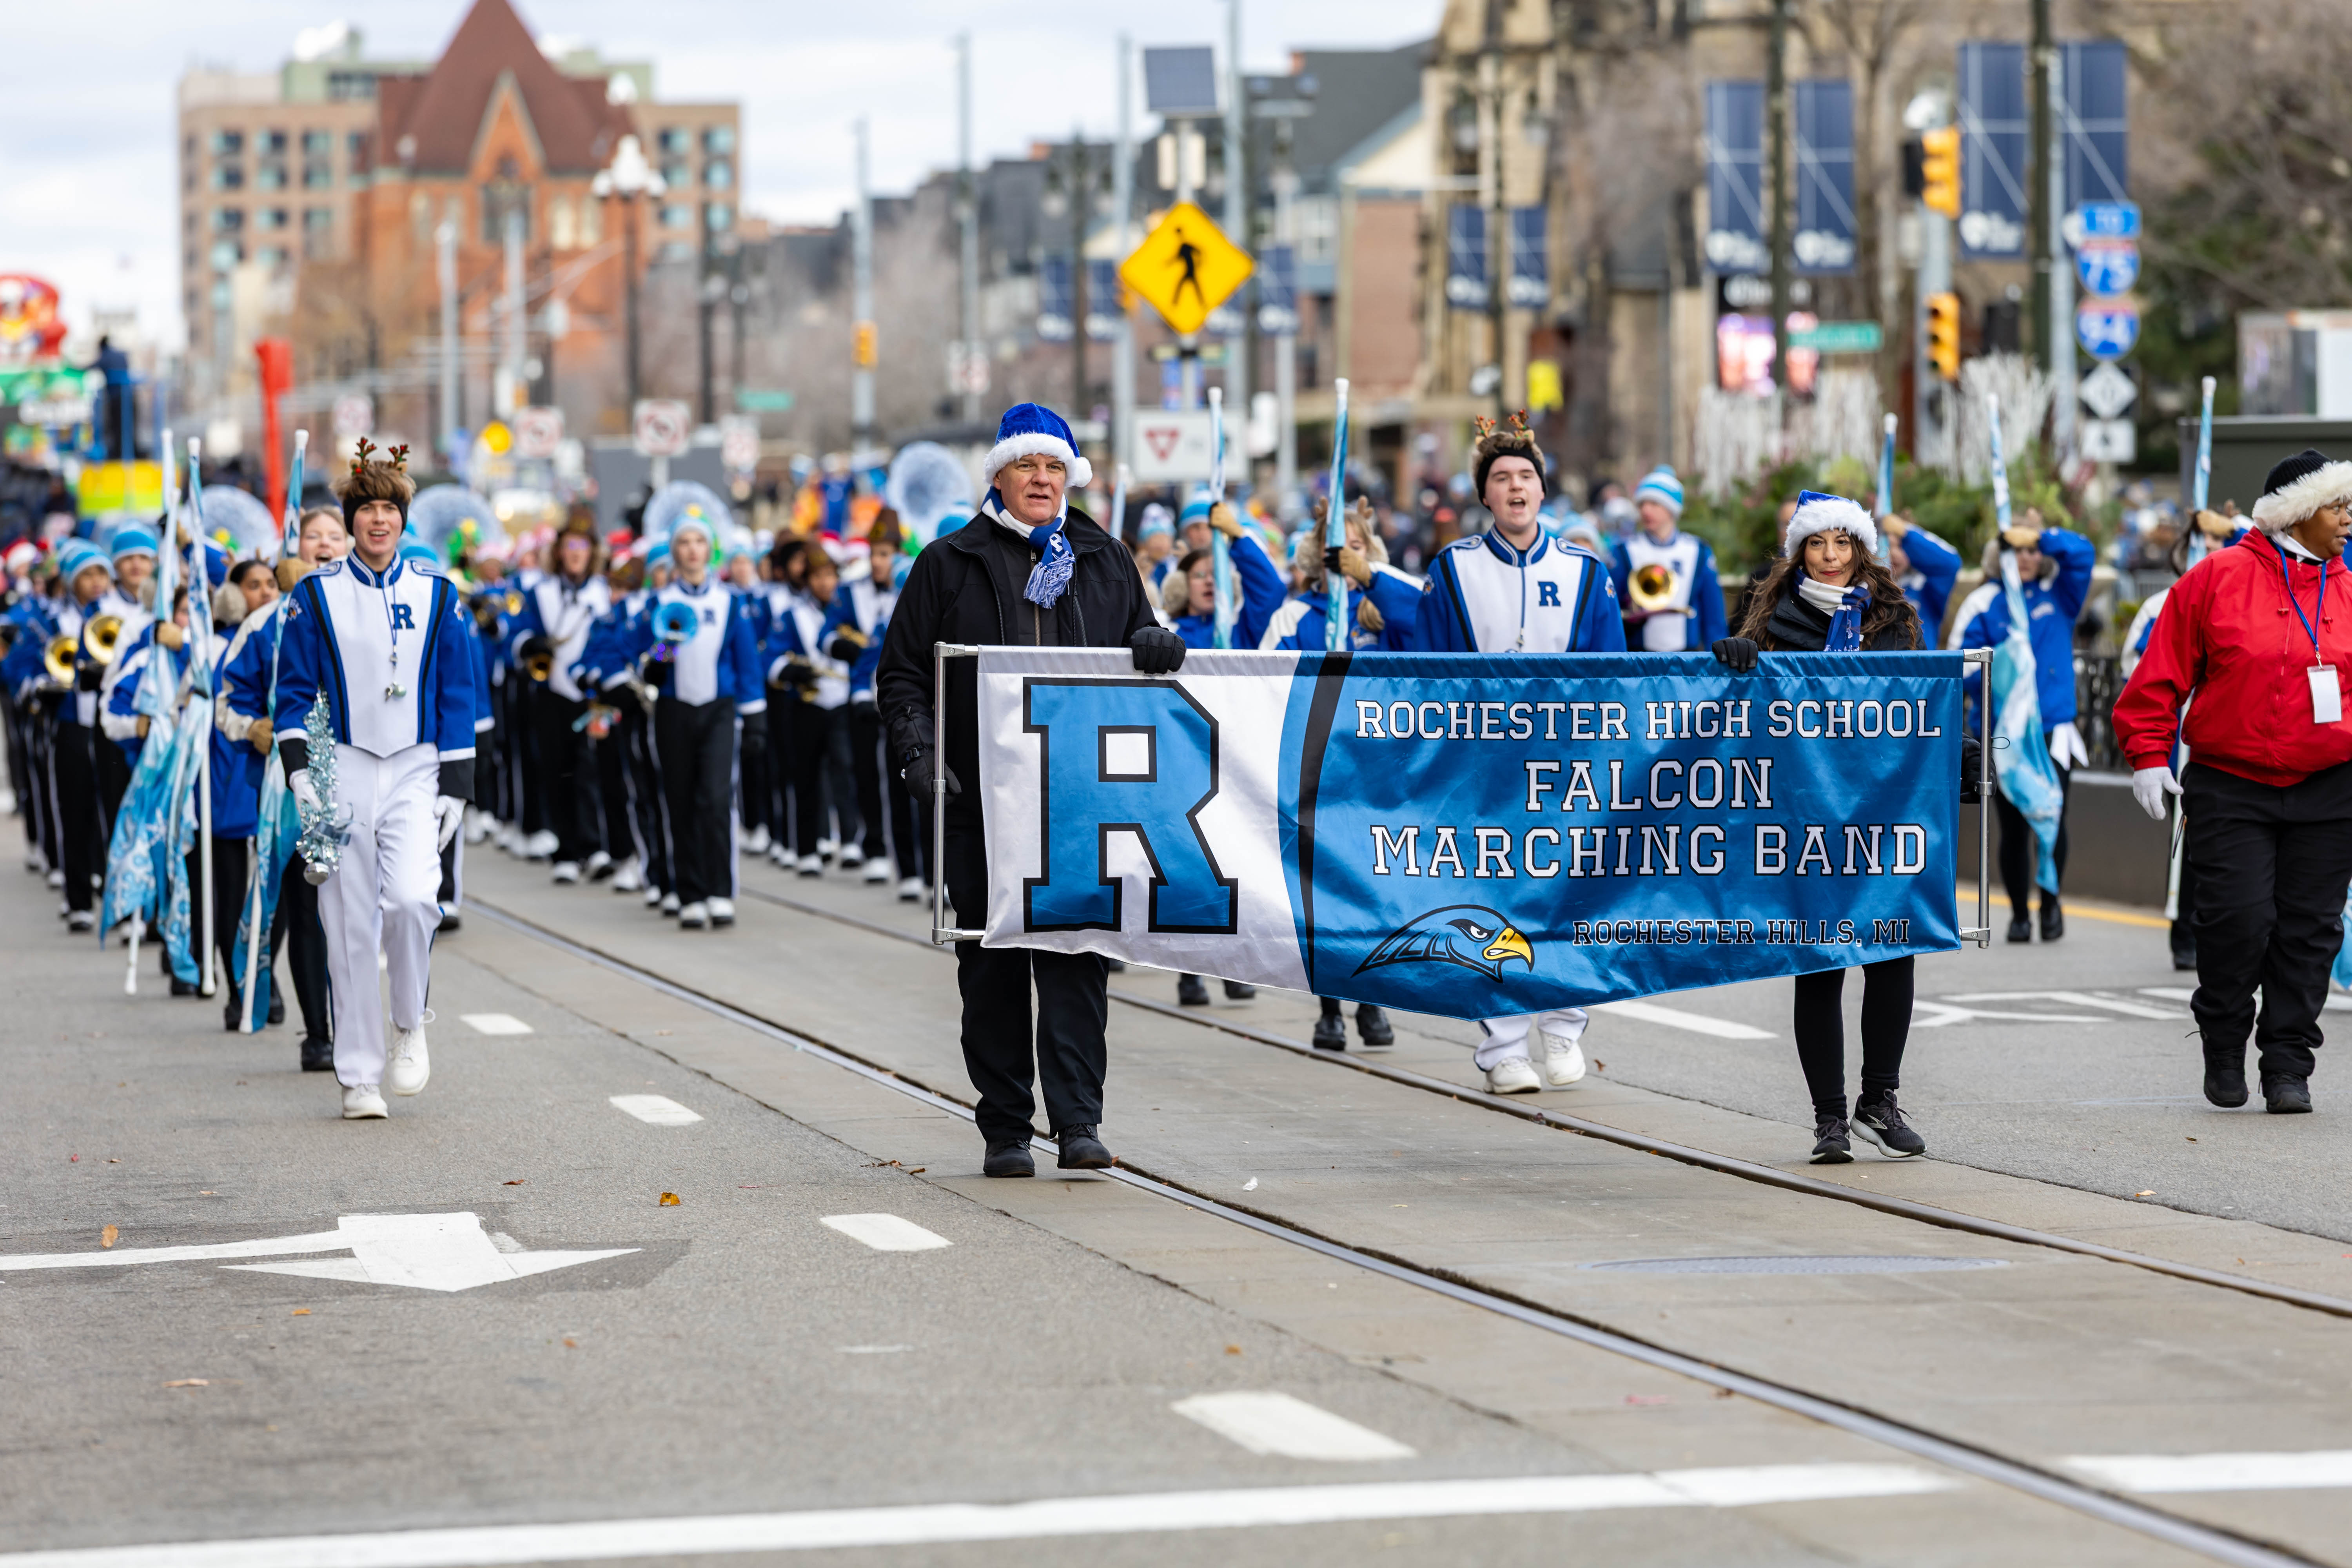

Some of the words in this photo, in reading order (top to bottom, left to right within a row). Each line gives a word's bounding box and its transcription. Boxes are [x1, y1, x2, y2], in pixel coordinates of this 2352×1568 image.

[2081, 249, 2134, 290] 75
[2080, 313, 2132, 350] 94
[1537, 581, 1561, 606] R
[391, 604, 415, 629] R
[1355, 700, 1630, 740] ROCHESTER
[1646, 700, 1752, 739] HIGH
[1767, 699, 1942, 739] SCHOOL
[1023, 677, 1238, 934] R
[1524, 757, 1774, 813] FALCON
[1370, 823, 1726, 879] MARCHING
[1754, 823, 1928, 877] BAND
[1573, 919, 1755, 946] ROCHESTER
[1766, 919, 1862, 947] HILLS,
[1873, 918, 1909, 944] MI
